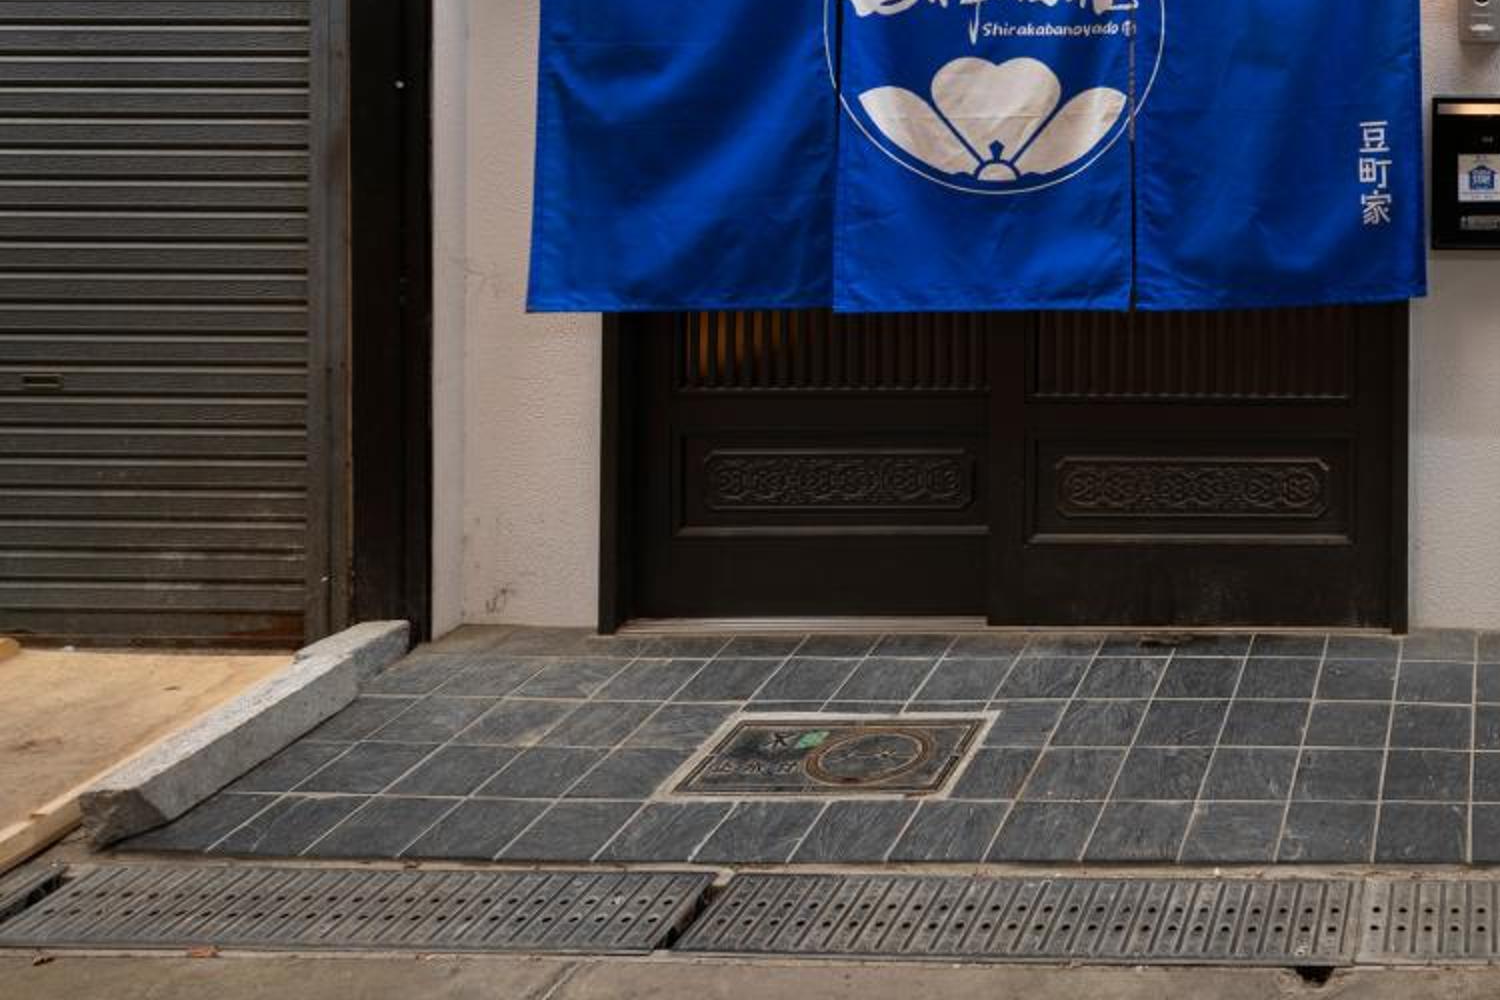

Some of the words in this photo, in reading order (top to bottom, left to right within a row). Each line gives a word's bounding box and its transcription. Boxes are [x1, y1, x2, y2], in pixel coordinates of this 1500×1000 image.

[981, 20, 1119, 38] Shirakabanoyado
[1358, 120, 1392, 225] 豆町家
